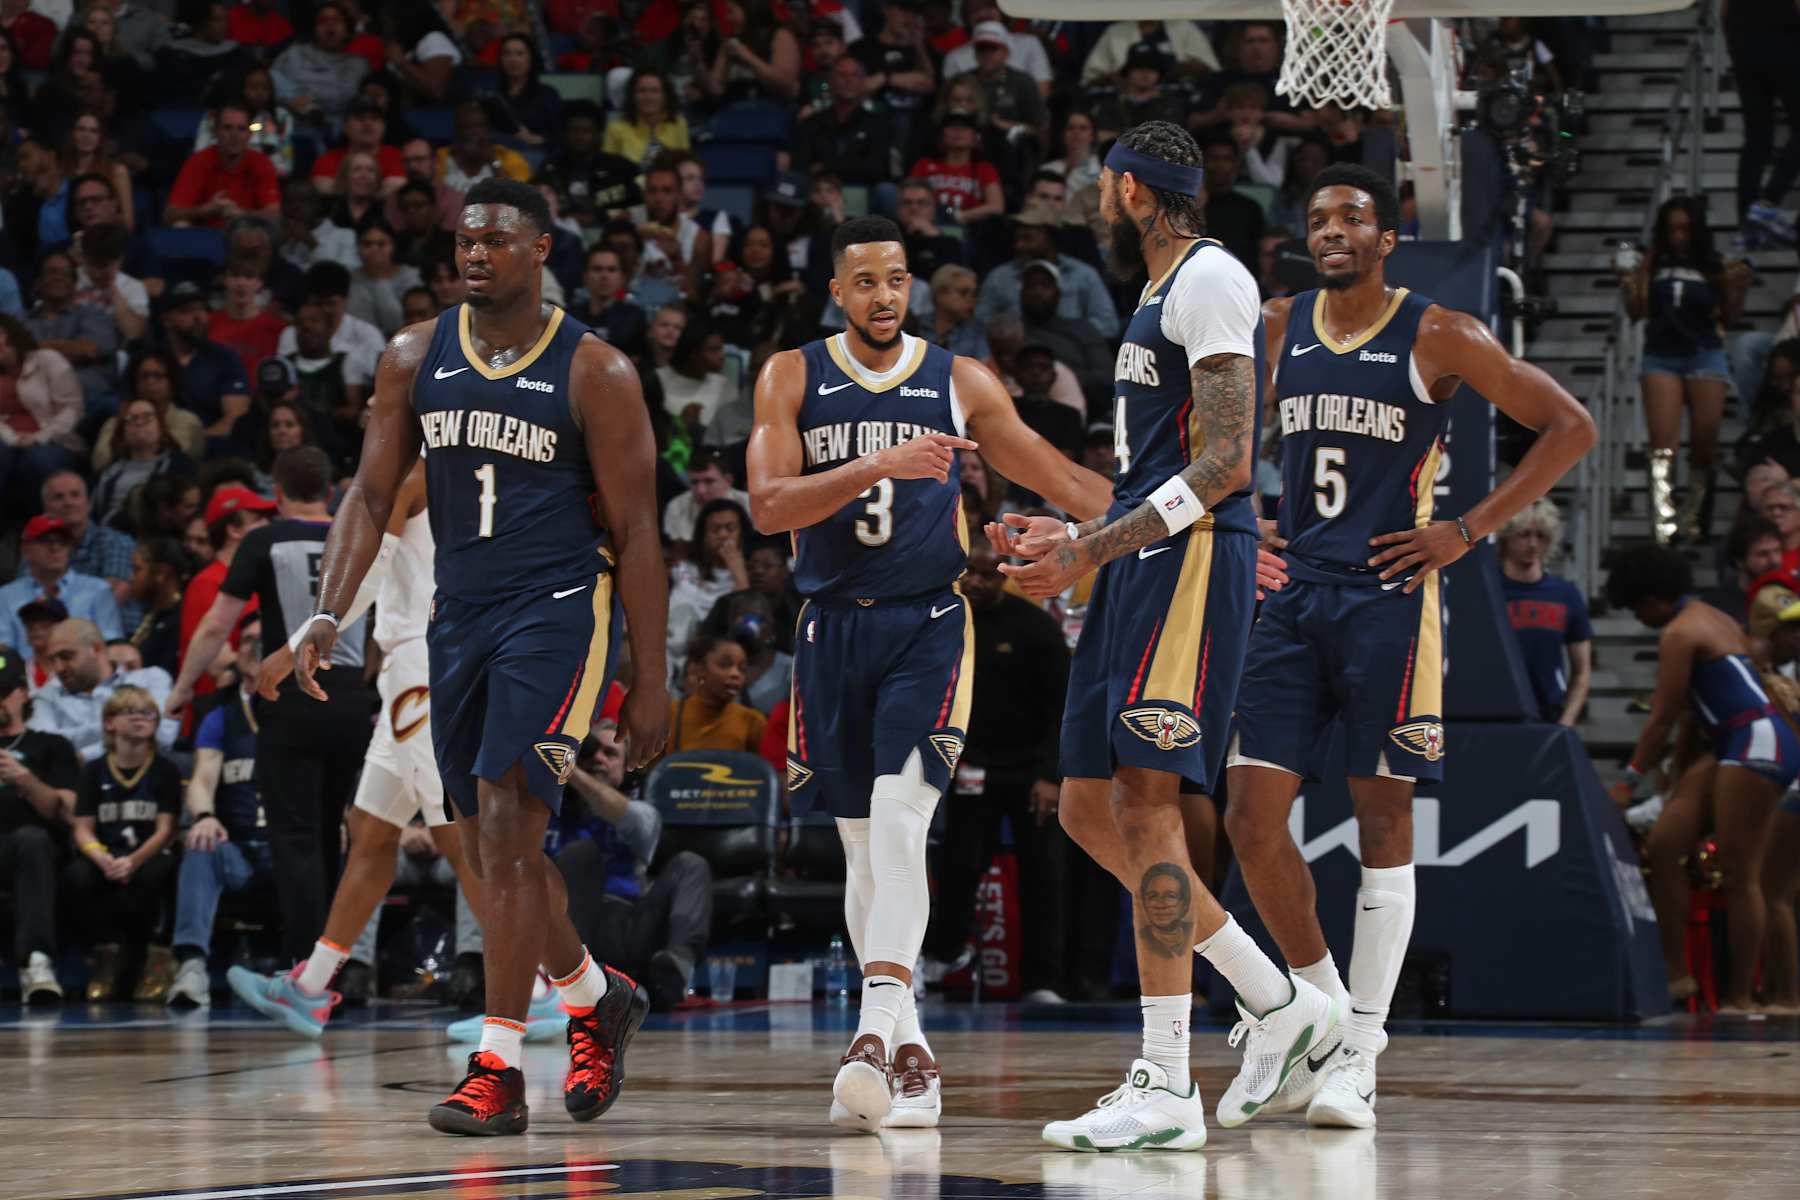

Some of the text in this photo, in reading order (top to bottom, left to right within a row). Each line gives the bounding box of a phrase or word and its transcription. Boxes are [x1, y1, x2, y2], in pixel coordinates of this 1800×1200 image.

[1359, 351, 1397, 363] ibotta
[516, 377, 554, 393] ibotta
[900, 386, 939, 399] ibotta
[420, 410, 558, 463] NEW ORLEANS
[1279, 393, 1406, 443] NEW ORLEANS
[803, 421, 947, 467] NEW ORLE
[473, 463, 498, 538] 1
[1314, 447, 1347, 519] 5
[855, 477, 894, 547] 3
[981, 948, 1008, 987] GO
